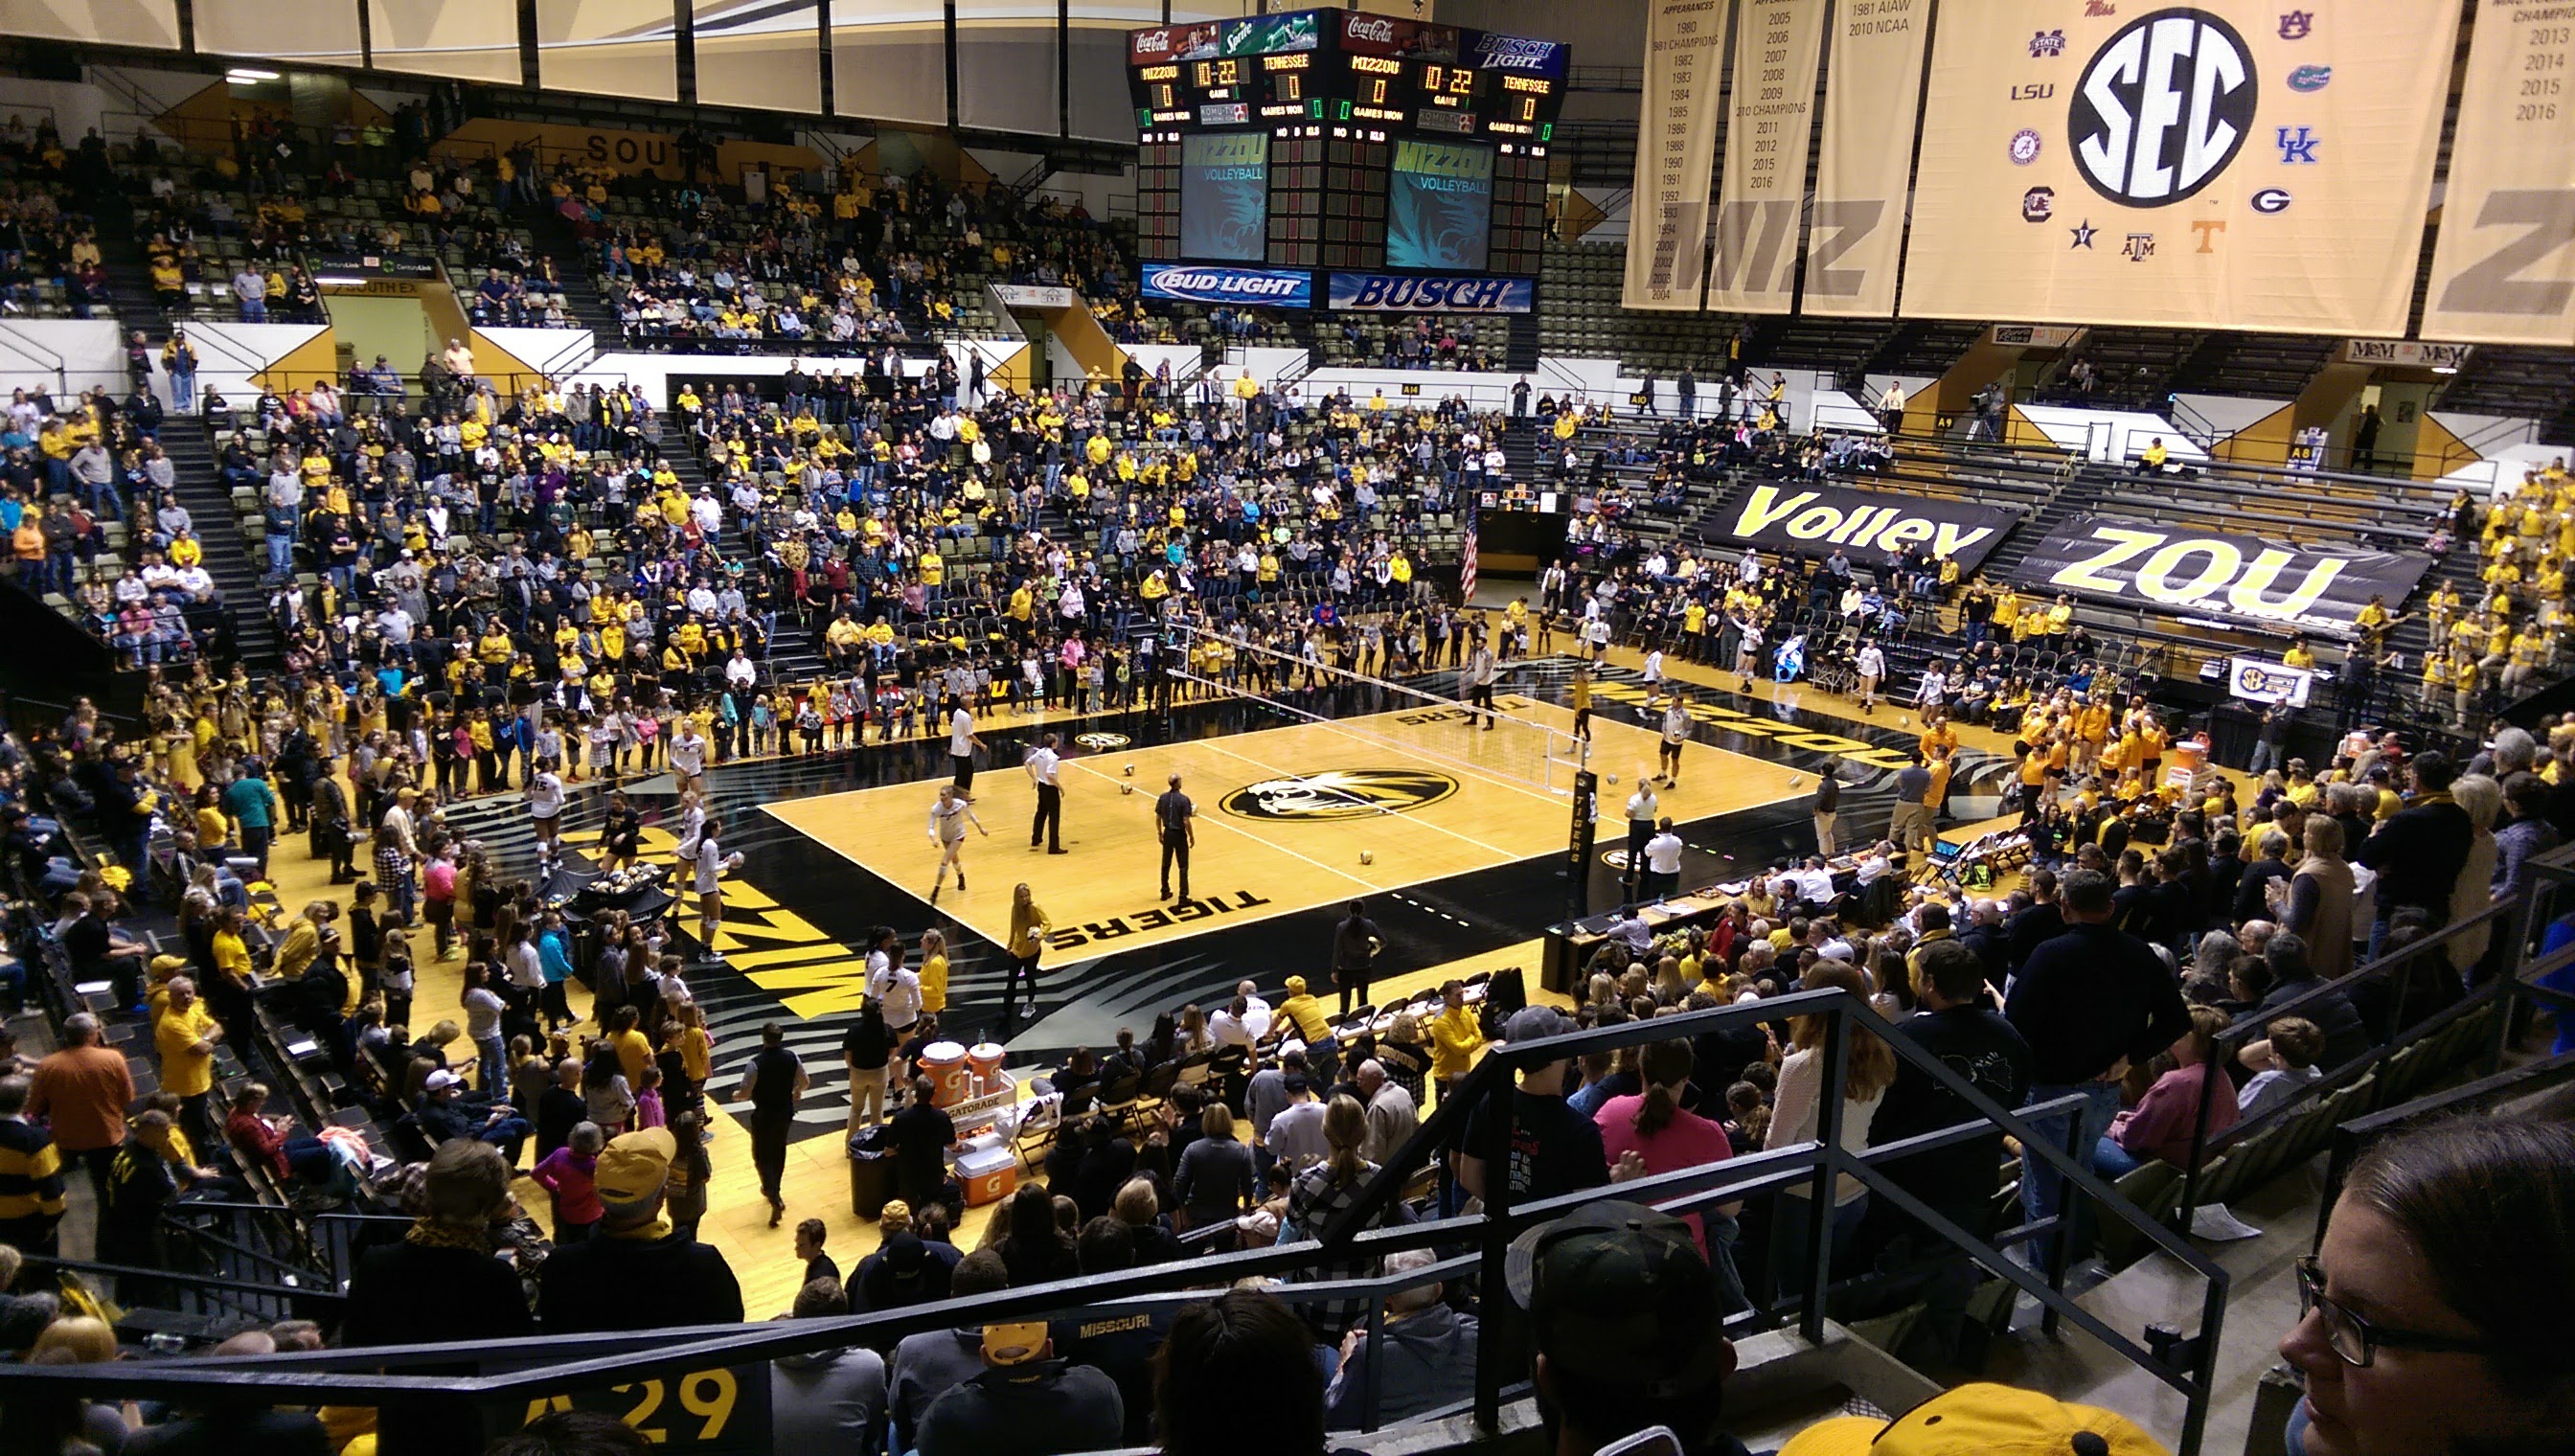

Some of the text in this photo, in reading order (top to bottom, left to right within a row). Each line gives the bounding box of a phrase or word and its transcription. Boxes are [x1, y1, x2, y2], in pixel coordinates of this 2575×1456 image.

[1663, 1, 1714, 15] APPEARANCES
[1853, 3, 1875, 16] 1981
[1768, 11, 1790, 25] 2005
[1676, 21, 1697, 34] 1980
[1849, 18, 1909, 36] 2010 NCAA
[1669, 34, 1718, 49] CHAMPIONS
[1766, 31, 1789, 44] 2006
[2529, 28, 2569, 45] 2013
[1474, 34, 1556, 58] BUSCH
[1264, 54, 1309, 70] TENNESSEE
[1480, 54, 1542, 69] LIGHT
[1765, 50, 1787, 62] 2007
[2525, 54, 2564, 71] 2014
[1143, 65, 1177, 80] MIZZOU
[1352, 56, 1400, 75] MIZZOU
[1763, 69, 1785, 81] 2008
[1504, 76, 1550, 94] TENNESSEE
[2012, 84, 2054, 100] LSU
[2520, 78, 2561, 96] 2015
[1209, 89, 1229, 99] GAME
[1434, 96, 1457, 106] GAME
[1671, 89, 1689, 101] 1984
[1761, 87, 1783, 100] 2009
[1262, 106, 1285, 116] GAMES
[1354, 107, 1403, 121] GAMES WON
[1753, 102, 1806, 116] CHAMPIONS
[2079, 18, 2245, 198] SEC
[2517, 103, 2556, 121] 2016
[1152, 112, 1174, 122] GAMES
[1489, 122, 1533, 134] GAMES WON
[1757, 123, 1778, 134] 2011
[1755, 140, 1776, 151] 2012
[2278, 128, 2319, 163] UK
[1394, 141, 1494, 179] MIZZOU
[1664, 157, 1682, 169] 1990
[1753, 158, 1774, 171] 2015
[1205, 168, 1263, 180] VOLLEYBALL
[1662, 174, 1680, 185] 1991
[1420, 177, 1488, 193] VOLLEYBALL
[1750, 176, 1772, 189] 2016
[2251, 189, 2290, 214] G
[2191, 220, 2226, 254] T
[1165, 273, 1301, 296] BUD LIGHT
[1351, 276, 1513, 311] BUSCH
[1652, 290, 1670, 300] 2004
[1732, 485, 1994, 559] Volley
[2049, 527, 2349, 619] ZOU
[2243, 668, 2267, 691] SEC
[534, 780, 548, 792] 15
[1571, 796, 1584, 862] TIGERS
[1053, 890, 1271, 950] TIGERS
[885, 979, 898, 992] 7
[946, 1070, 961, 1090] G
[948, 1098, 1000, 1119] GATORADE
[987, 1175, 1001, 1194] G
[1080, 1313, 1150, 1339] MISSOURI
